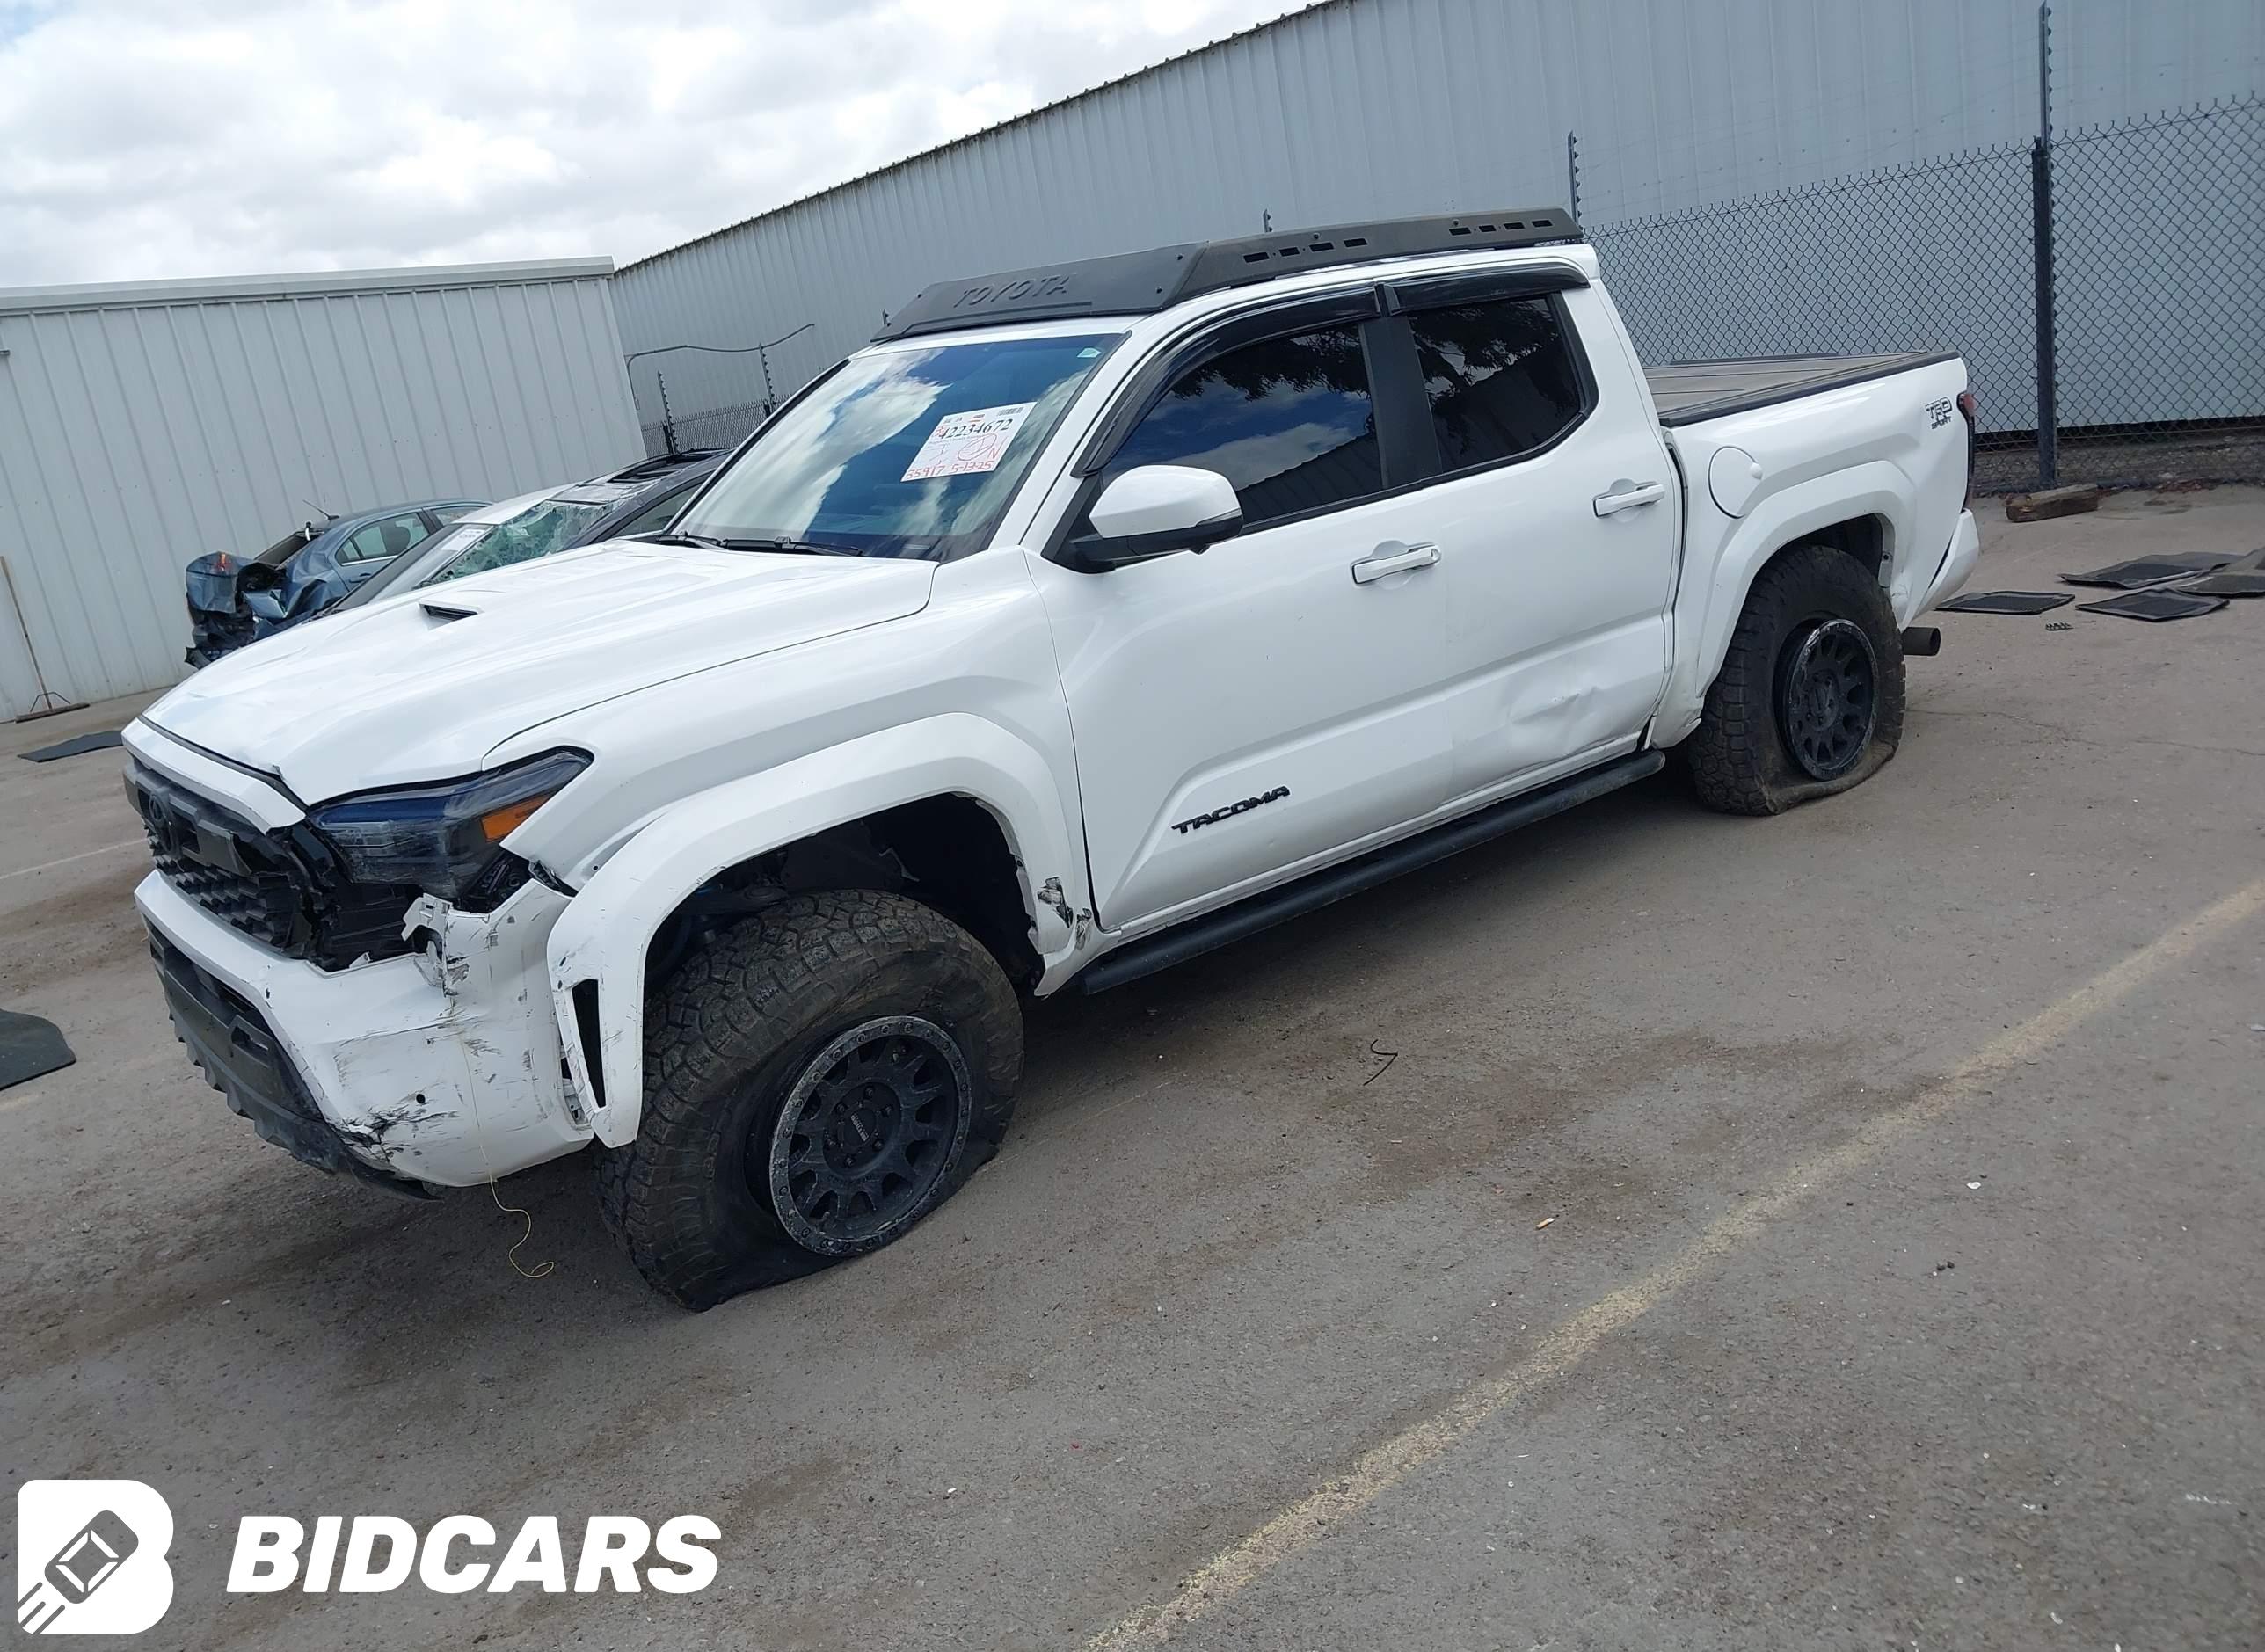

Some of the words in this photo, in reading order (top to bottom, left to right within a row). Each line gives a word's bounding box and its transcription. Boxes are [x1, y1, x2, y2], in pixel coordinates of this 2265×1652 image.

[953, 274, 1070, 308] TOYOTA
[1925, 397, 1953, 422] TRD
[939, 418, 1014, 439] 42234672
[1171, 785, 1290, 834] TACOMA
